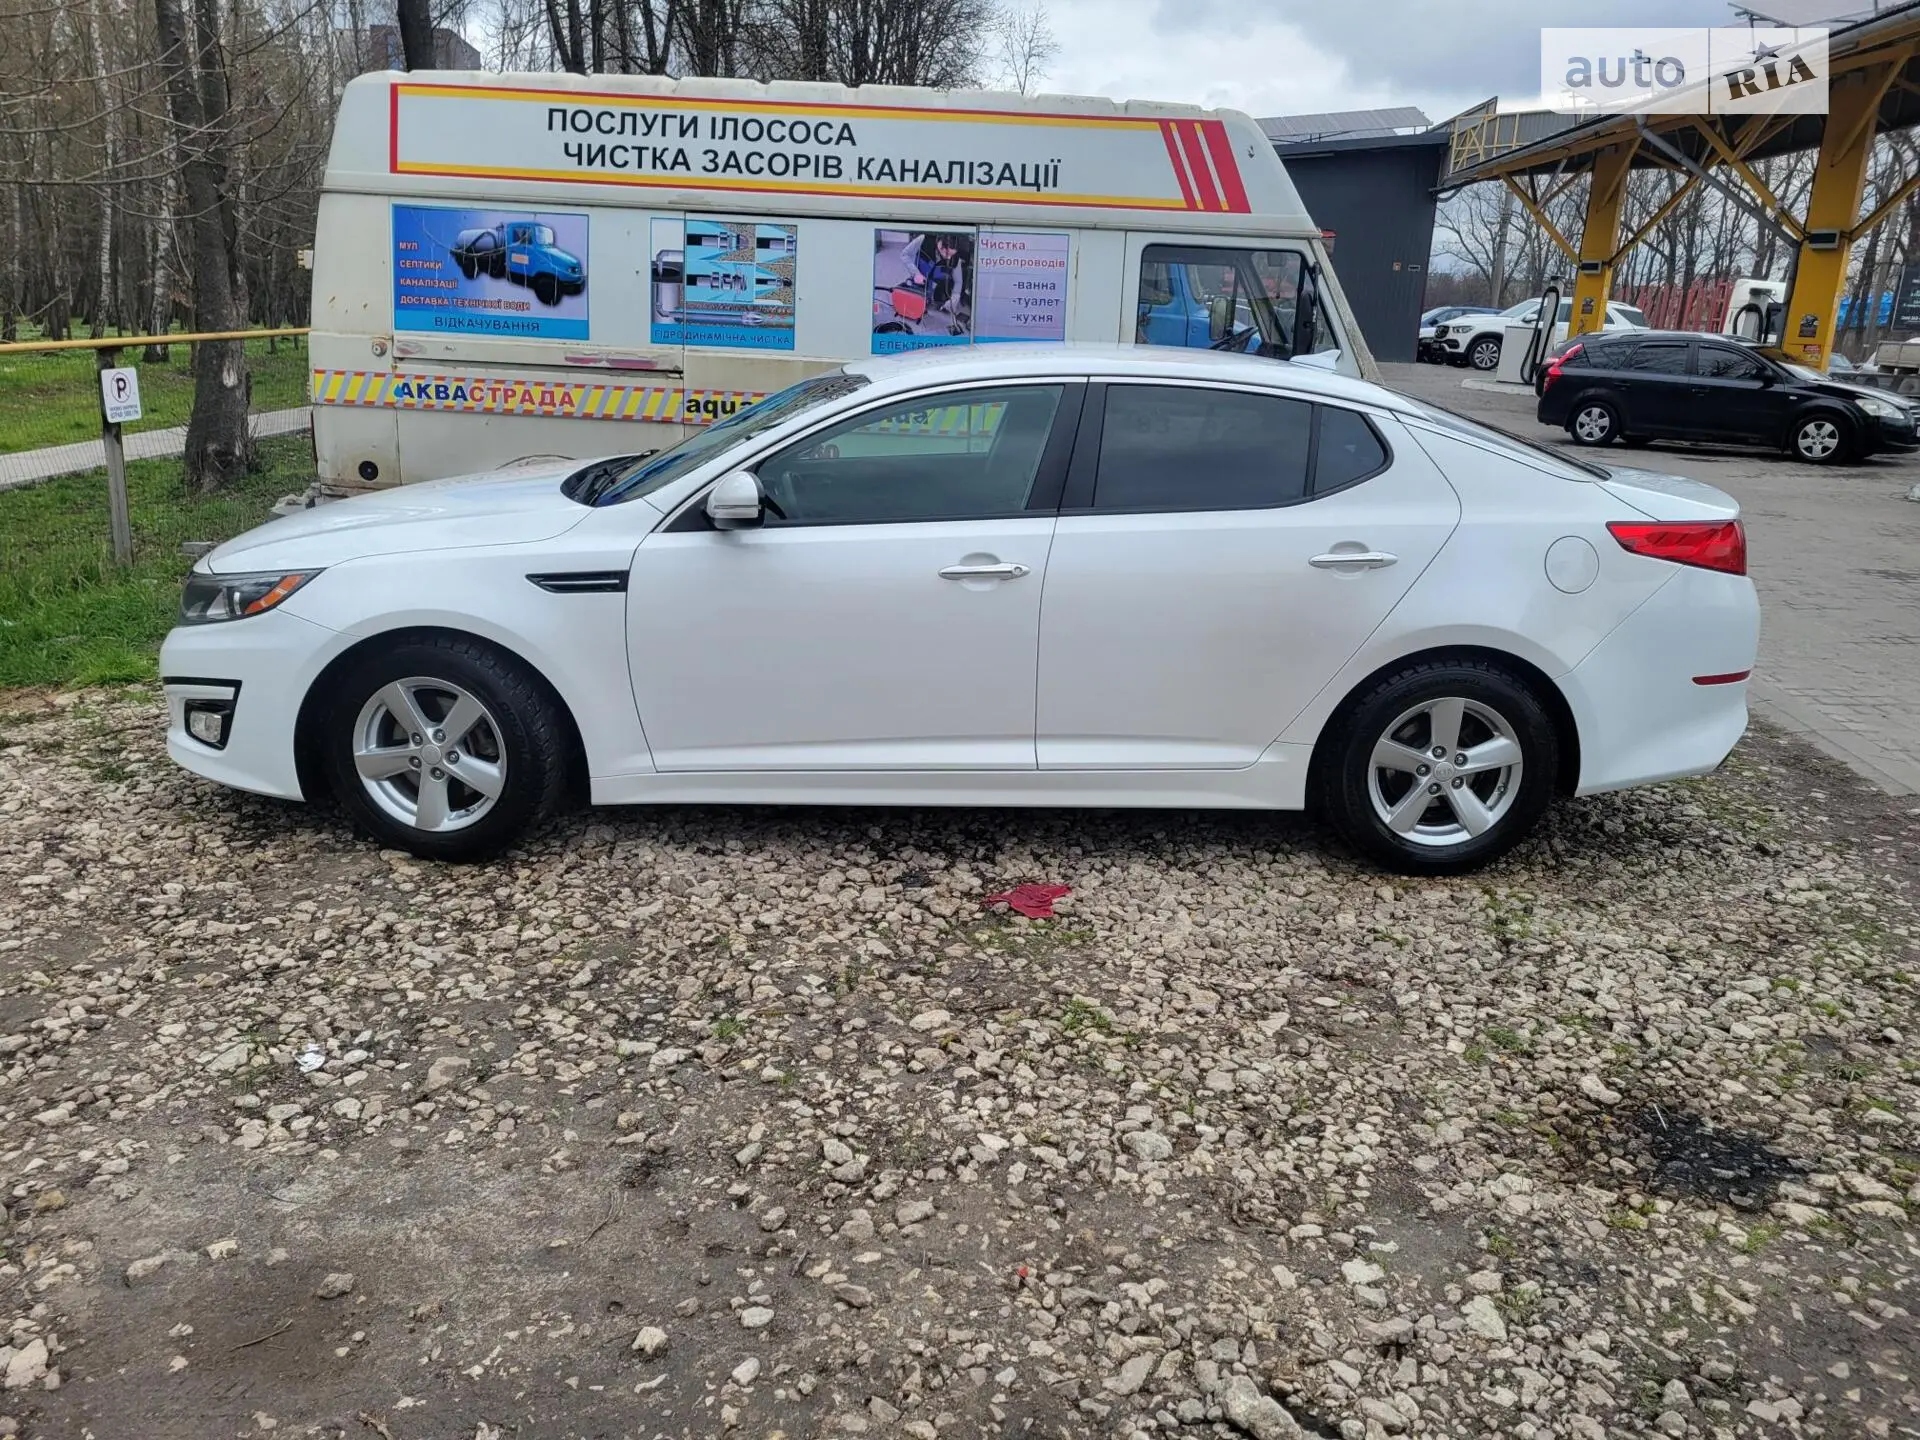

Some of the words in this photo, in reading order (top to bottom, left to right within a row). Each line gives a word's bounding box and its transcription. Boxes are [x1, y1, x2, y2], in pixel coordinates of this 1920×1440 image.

[547, 108, 698, 139] ПОСЛУГИ
[710, 116, 857, 147] ІЛОСОСА
[563, 142, 691, 172] ЧИСТКА
[701, 148, 843, 179] ЗАСОРІВ
[856, 156, 1062, 193] КАНАЛІЗАЦІЇ
[400, 242, 418, 250] МУЛ
[980, 239, 1026, 250] Чистка
[400, 260, 442, 269] СЕПТИКИ
[979, 256, 1065, 269] трубопроводів
[400, 278, 458, 289] КАНАЛІЗАЦІЇ
[1013, 280, 1056, 291] -ванна
[400, 295, 449, 306] ДОСТАВКА
[452, 298, 503, 309] ТЕХНІЧНОЇ
[503, 301, 530, 311] ВОДИ
[1012, 297, 1061, 309] -туалет
[434, 317, 540, 331] ВІДКАЧУВАННЯ
[1011, 314, 1053, 324] -кухня
[654, 329, 750, 341] ГІДРОДИНАМІЧНА
[751, 335, 791, 344] ЧИСТКА
[401, 382, 576, 408] АКВАСТРАДА
